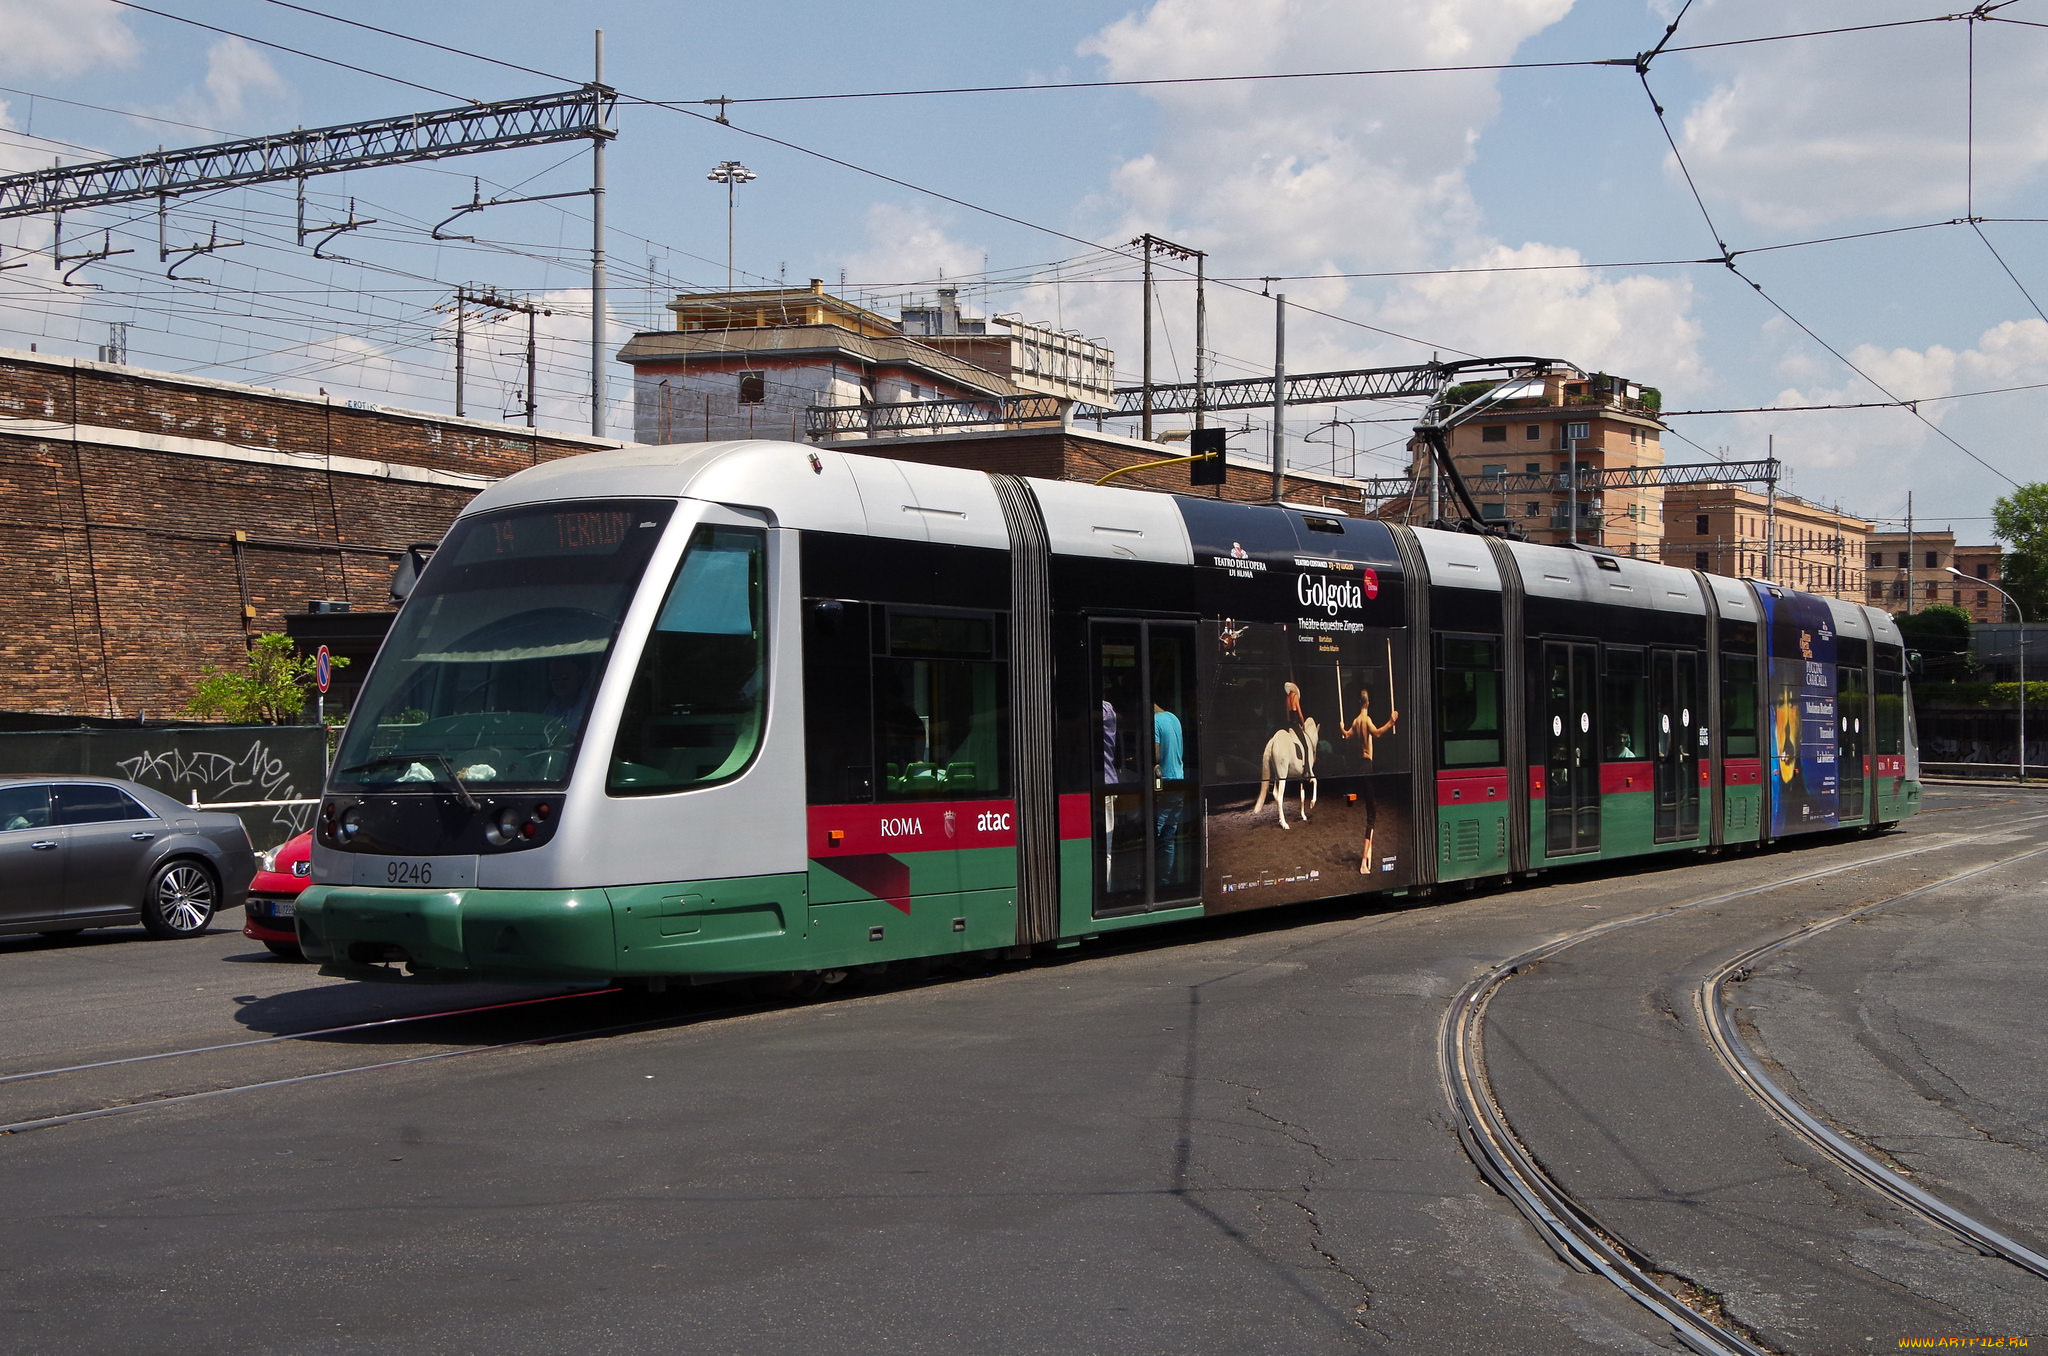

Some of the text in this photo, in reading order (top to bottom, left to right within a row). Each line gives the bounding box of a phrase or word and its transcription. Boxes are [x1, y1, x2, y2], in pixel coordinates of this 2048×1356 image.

[1213, 556, 1267, 571] TEATRO DELL'OPERA
[1297, 572, 1362, 616] Golgota
[1297, 617, 1320, 630] Théâtre
[1343, 620, 1364, 634] Zingaro
[881, 810, 1010, 837] ROMA atac
[387, 861, 432, 884] 9246
